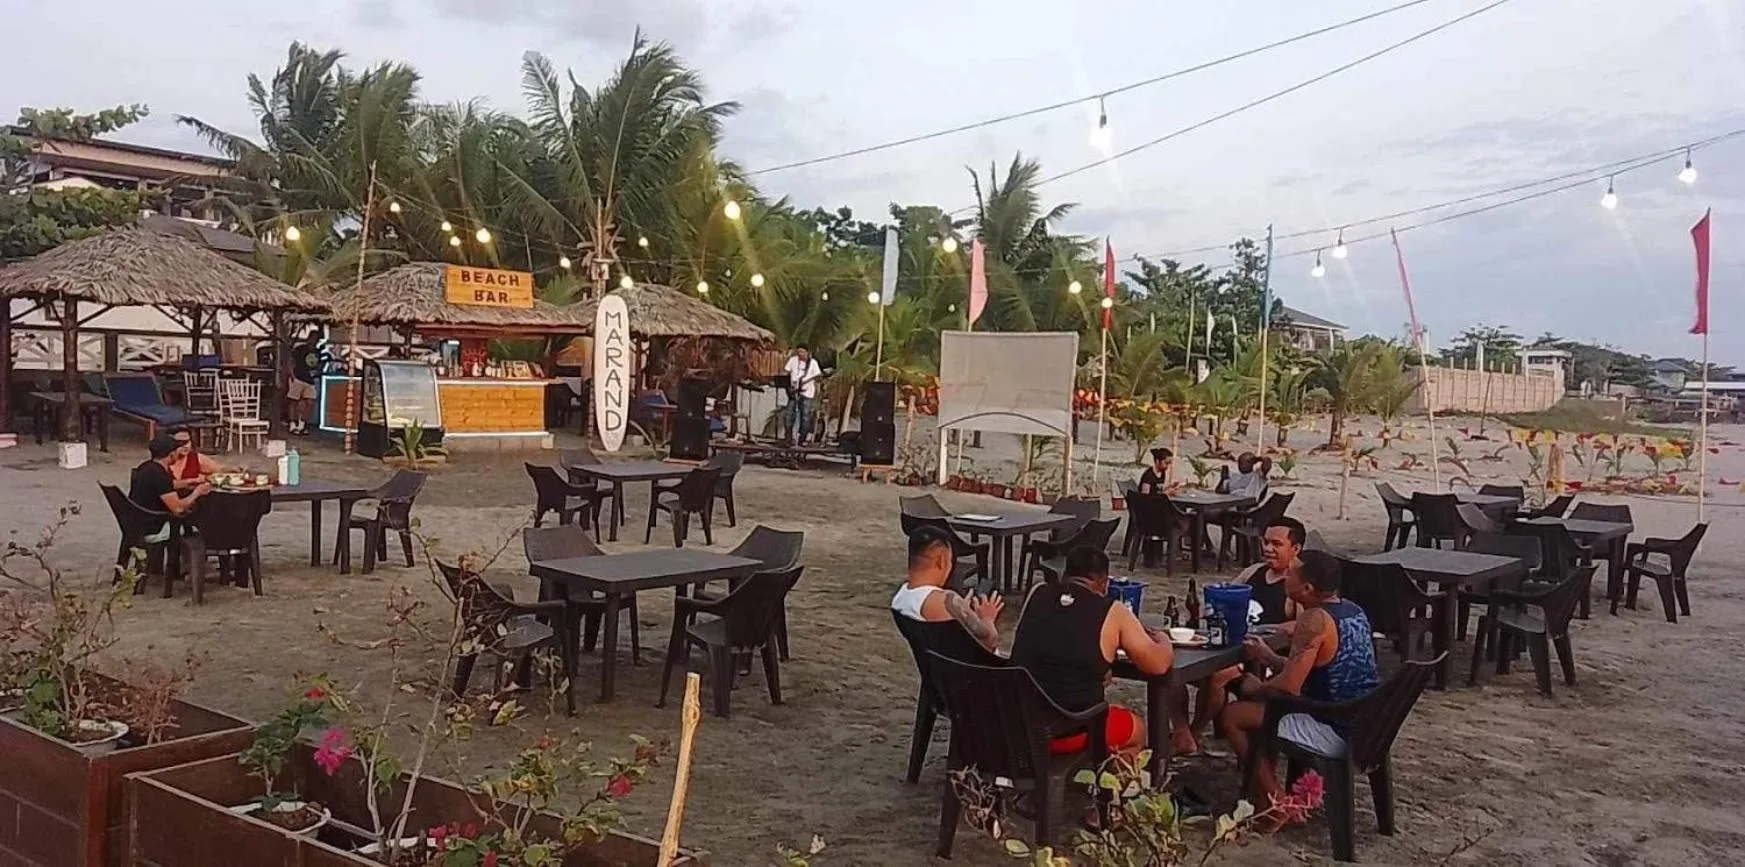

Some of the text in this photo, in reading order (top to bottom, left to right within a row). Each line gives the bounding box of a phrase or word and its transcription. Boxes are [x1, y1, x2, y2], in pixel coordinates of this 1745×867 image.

[461, 269, 519, 286] BEACH
[474, 289, 509, 303] BAR
[605, 311, 623, 431] MARAND
